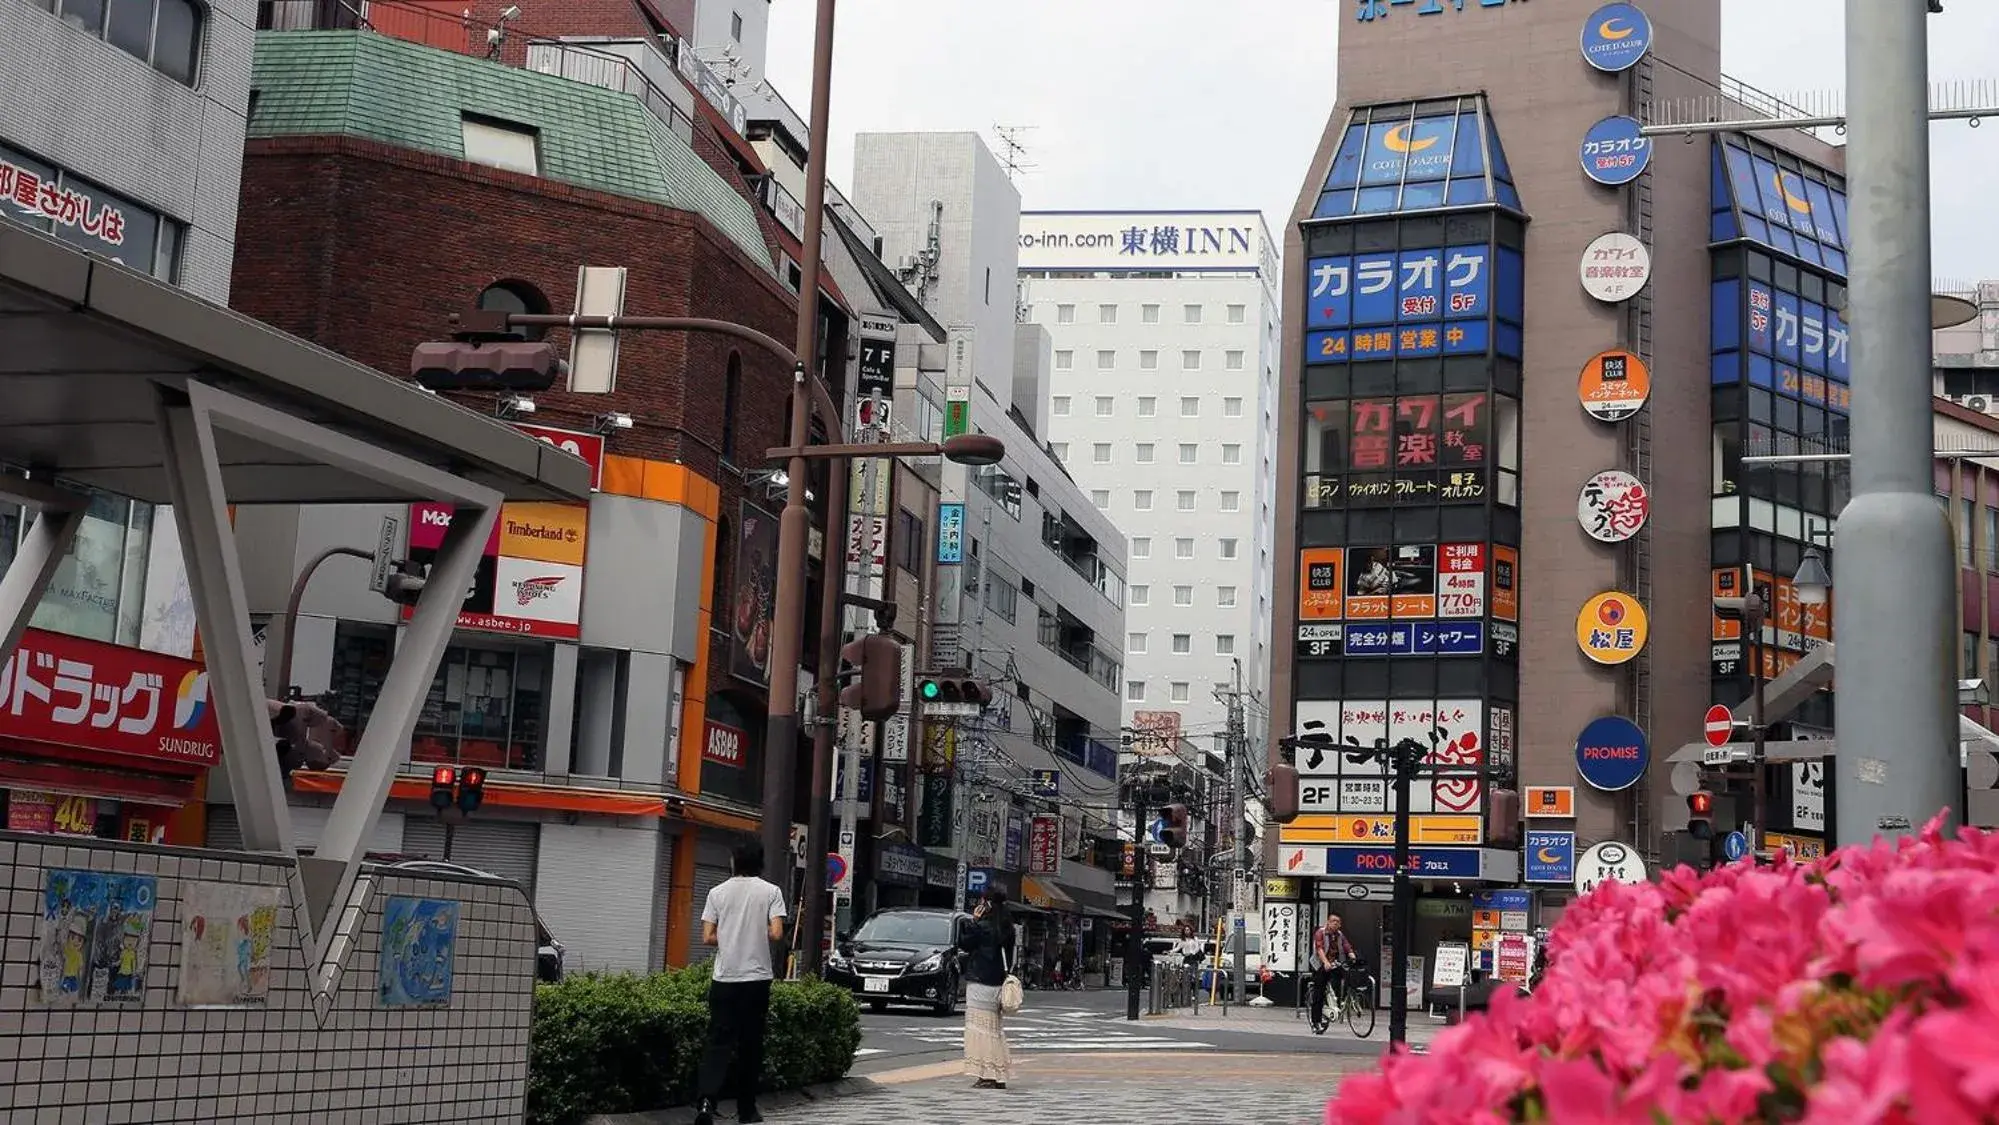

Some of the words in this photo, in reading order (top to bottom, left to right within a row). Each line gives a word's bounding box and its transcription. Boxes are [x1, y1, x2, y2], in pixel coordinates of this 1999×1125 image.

[1584, 137, 1646, 154] カラオケ
[1592, 247, 1638, 261] カワイ
[1312, 254, 1484, 298] カラオケ
[1585, 265, 1645, 279] 音楽教室
[1402, 296, 1436, 315] 受付
[1450, 294, 1476, 312] 5F
[1752, 312, 1767, 330] 5F
[1353, 396, 1484, 433] カワイ
[1450, 473, 1475, 486] 電子
[1308, 482, 1338, 497] ピアノ
[1395, 480, 1438, 494] フルート
[1441, 483, 1484, 498] オルガン
[507, 519, 563, 541] Timberland
[949, 507, 960, 550] 金子内科
[1446, 545, 1478, 557] ご利用
[1450, 559, 1473, 570] 料金
[1440, 593, 1481, 608] 770円
[1319, 629, 1340, 637] OPEN
[1350, 631, 1406, 647] 完全分煙
[1422, 630, 1477, 645] シャワー
[1589, 628, 1634, 649] 松屋
[1310, 642, 1330, 655] 3F
[1496, 641, 1510, 655] 3F
[1719, 662, 1735, 674] 3F
[159, 736, 214, 758] SUNDRUG
[1584, 747, 1639, 760] PROMISE
[1345, 782, 1380, 793] 営業時間
[1302, 787, 1330, 804] 2F
[55, 798, 88, 832] 40
[1796, 805, 1809, 819] 2F
[1529, 836, 1568, 846] カラオケ
[1424, 861, 1449, 870] プロミス
[1267, 906, 1280, 965] ルノアール
